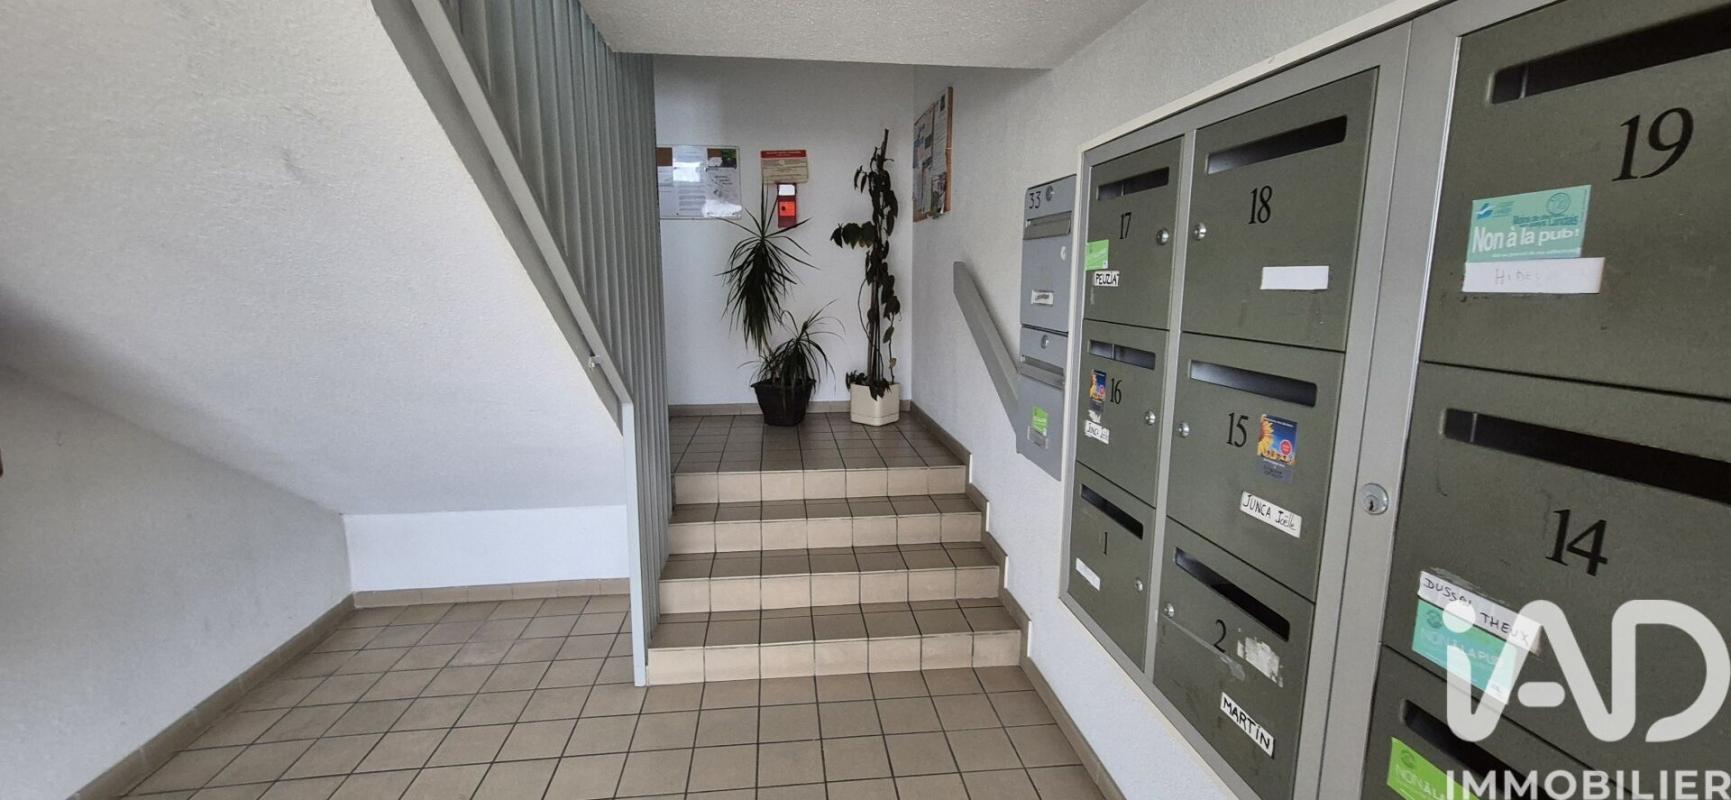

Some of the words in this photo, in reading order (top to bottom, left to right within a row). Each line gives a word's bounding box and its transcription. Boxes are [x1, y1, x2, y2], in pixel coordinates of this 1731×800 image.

[1612, 107, 1694, 181] 19
[1029, 191, 1041, 209] 33
[1248, 185, 1272, 224] 18
[1120, 212, 1132, 239] 17
[1472, 226, 1502, 252] Non
[1506, 226, 1517, 248] à
[1520, 227, 1535, 245] la
[1110, 378, 1122, 404] 16
[1226, 412, 1248, 448] 15
[1242, 495, 1271, 518] JUNCA
[1103, 532, 1108, 555] 1
[1545, 509, 1608, 577] 14
[1213, 619, 1227, 654] 2
[1223, 697, 1270, 749] MARTIN
